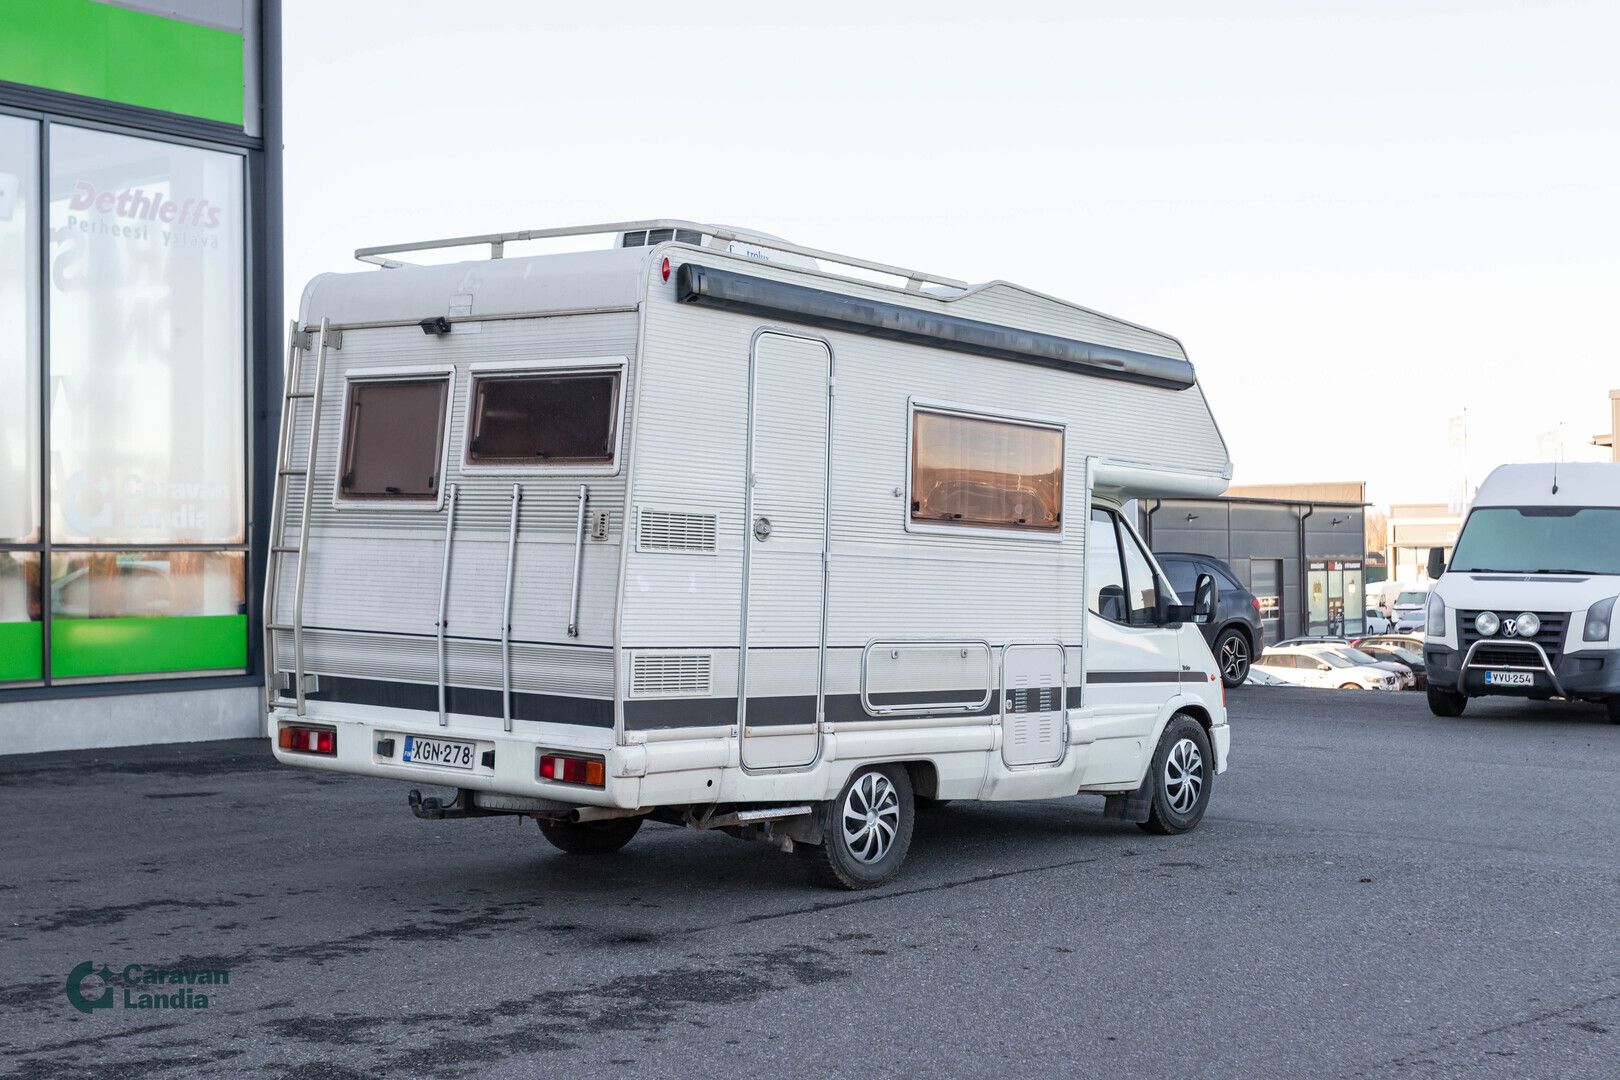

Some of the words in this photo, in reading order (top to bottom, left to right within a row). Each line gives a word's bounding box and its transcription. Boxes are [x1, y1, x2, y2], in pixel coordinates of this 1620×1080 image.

[68, 179, 222, 229] Dethleffs
[67, 215, 149, 241] Perheesi
[414, 740, 471, 765] XGN-278
